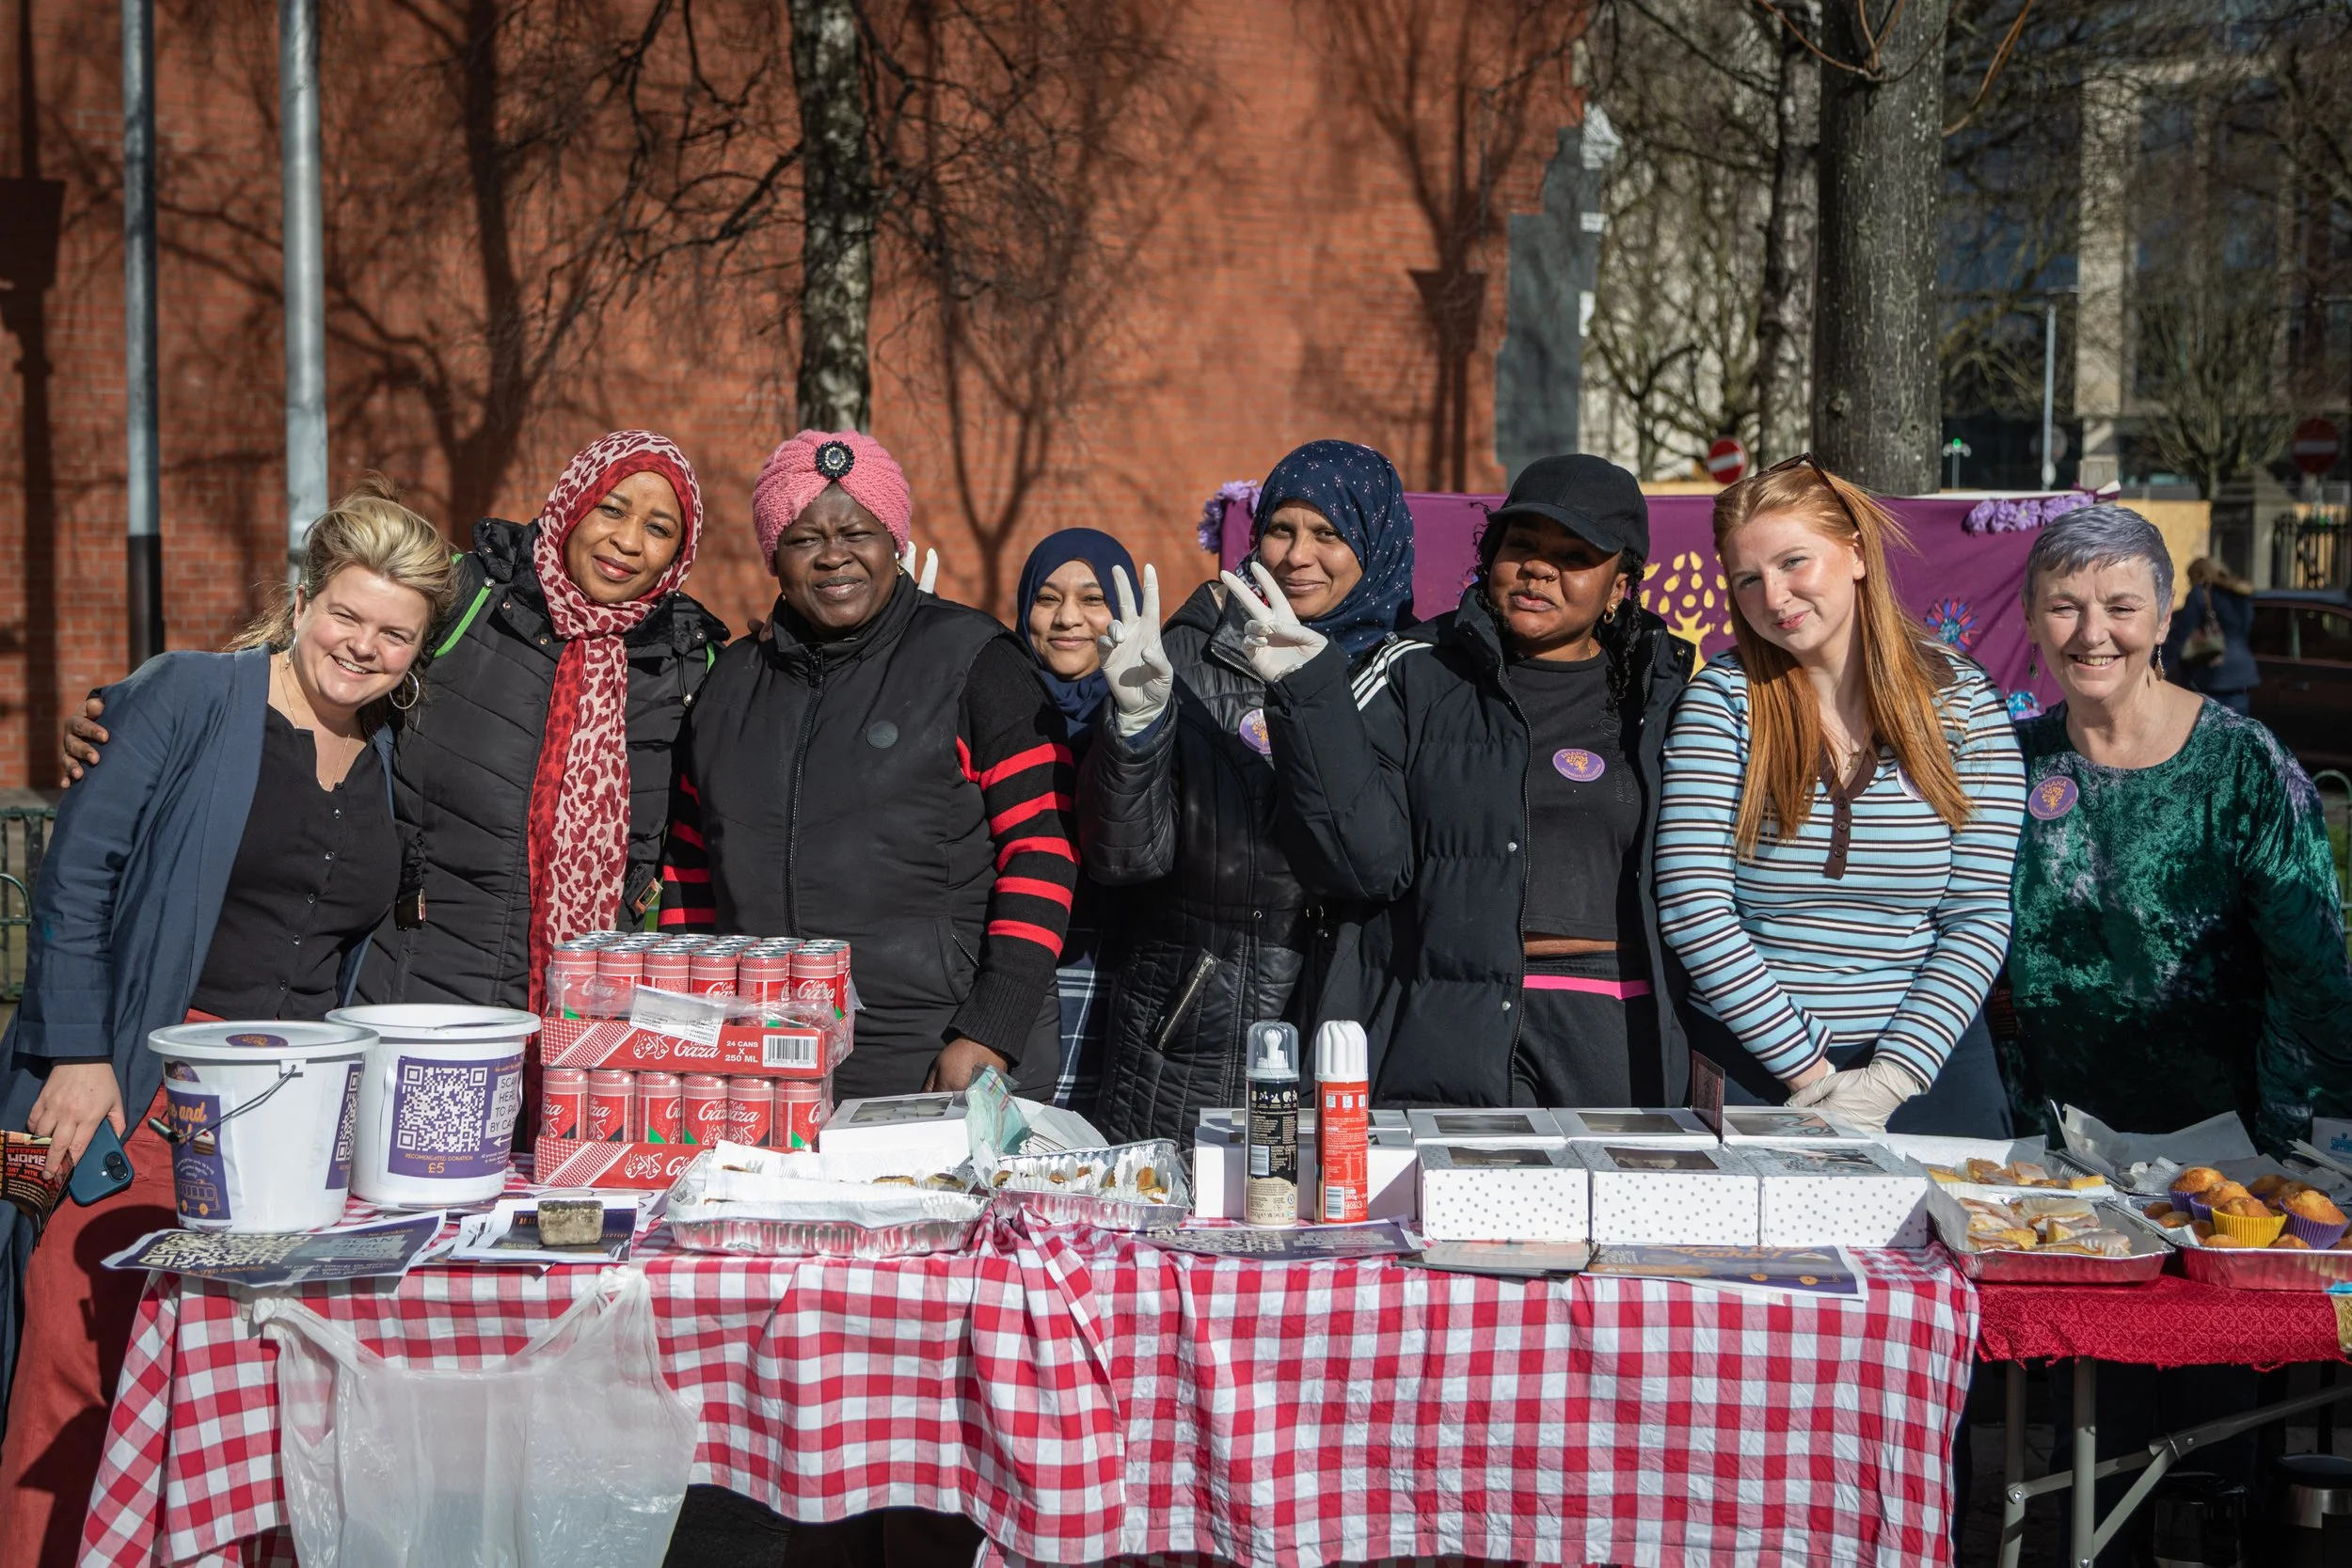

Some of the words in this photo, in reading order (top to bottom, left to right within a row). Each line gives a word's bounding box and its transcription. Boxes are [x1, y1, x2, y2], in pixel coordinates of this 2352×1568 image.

[798, 980, 835, 1000] Gaza
[813, 980, 828, 989] Cola
[674, 1037, 721, 1058] Gaza
[744, 1054, 759, 1063] ML
[179, 1101, 207, 1123] and
[495, 1106, 506, 1117] TO
[543, 1103, 564, 1116] za
[698, 1100, 727, 1121] Gaz
[728, 1110, 761, 1123] aza
[490, 1122, 500, 1132] BY
[8, 1153, 46, 1166] WOME
[428, 1162, 445, 1174] £5
[1692, 1250, 1784, 1259] cake!
